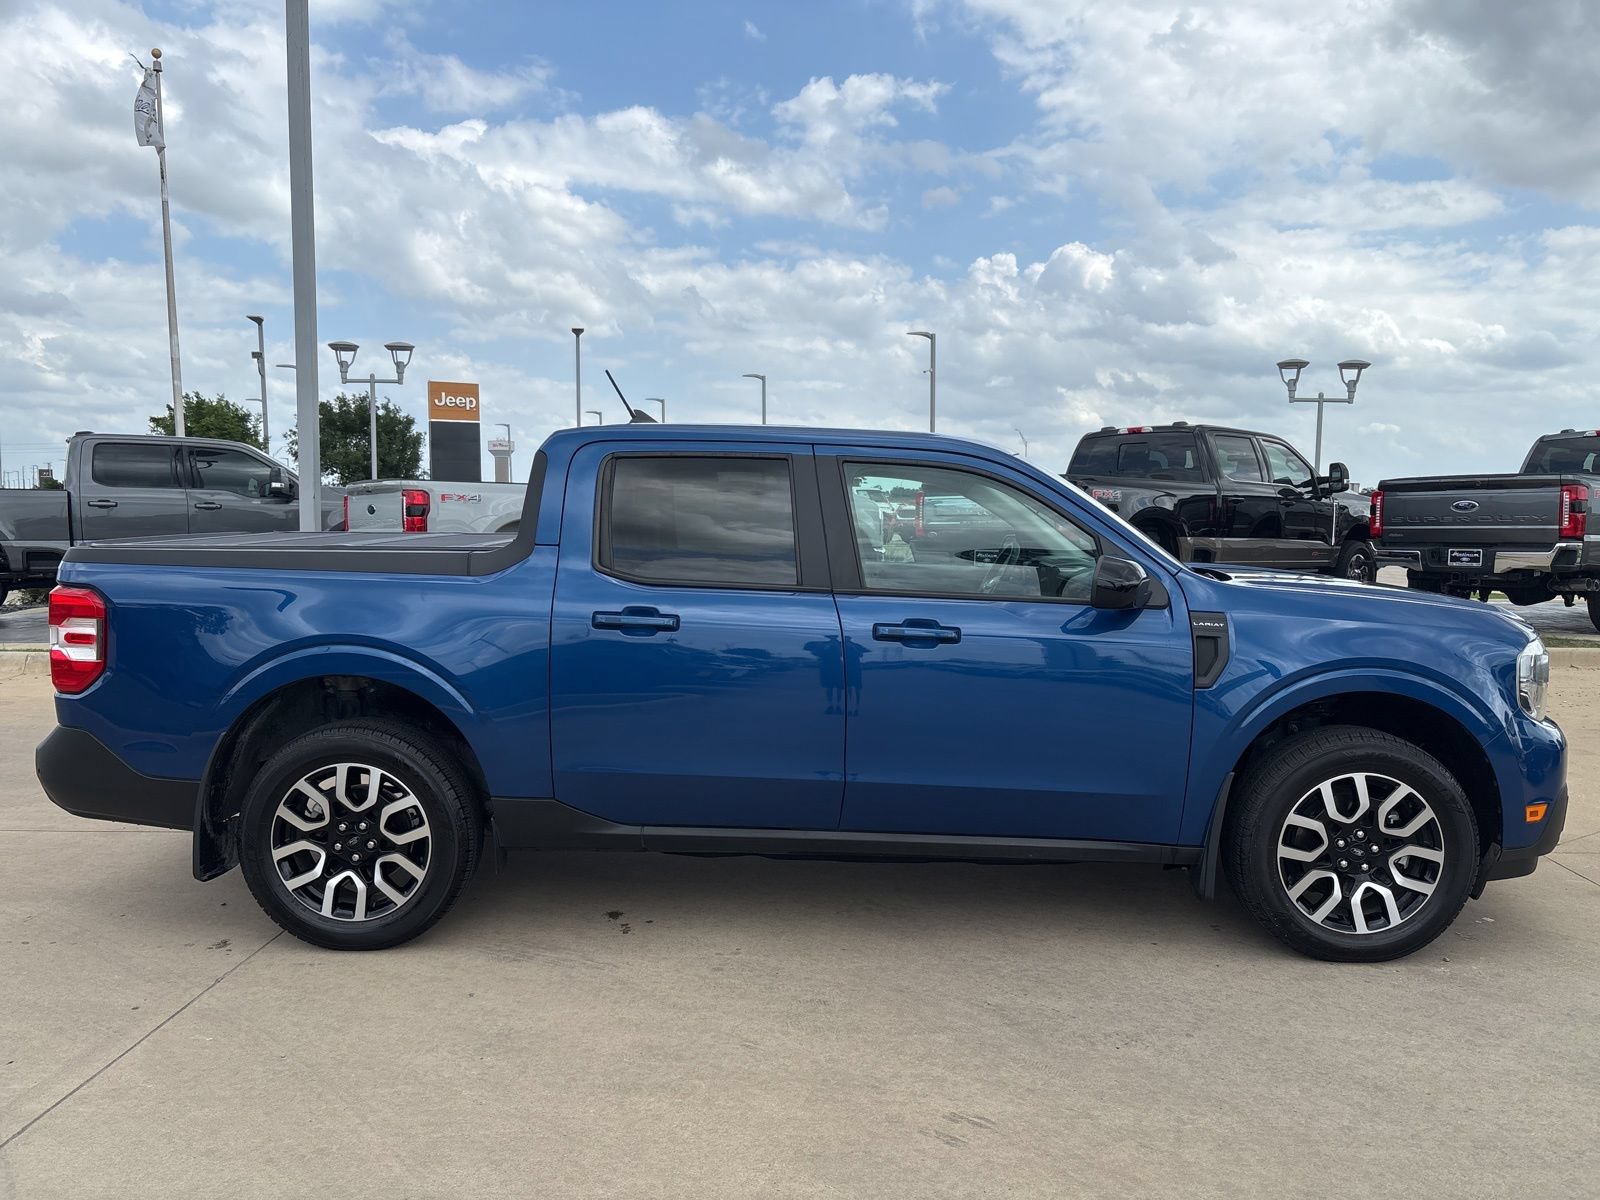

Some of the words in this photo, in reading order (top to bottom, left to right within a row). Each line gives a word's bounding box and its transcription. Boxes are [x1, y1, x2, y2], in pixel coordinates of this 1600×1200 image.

[434, 391, 477, 410] Jeep
[440, 493, 481, 503] FX4
[1092, 489, 1121, 500] FX4
[1391, 515, 1470, 523] SUPER
[1478, 514, 1548, 523] DUTY
